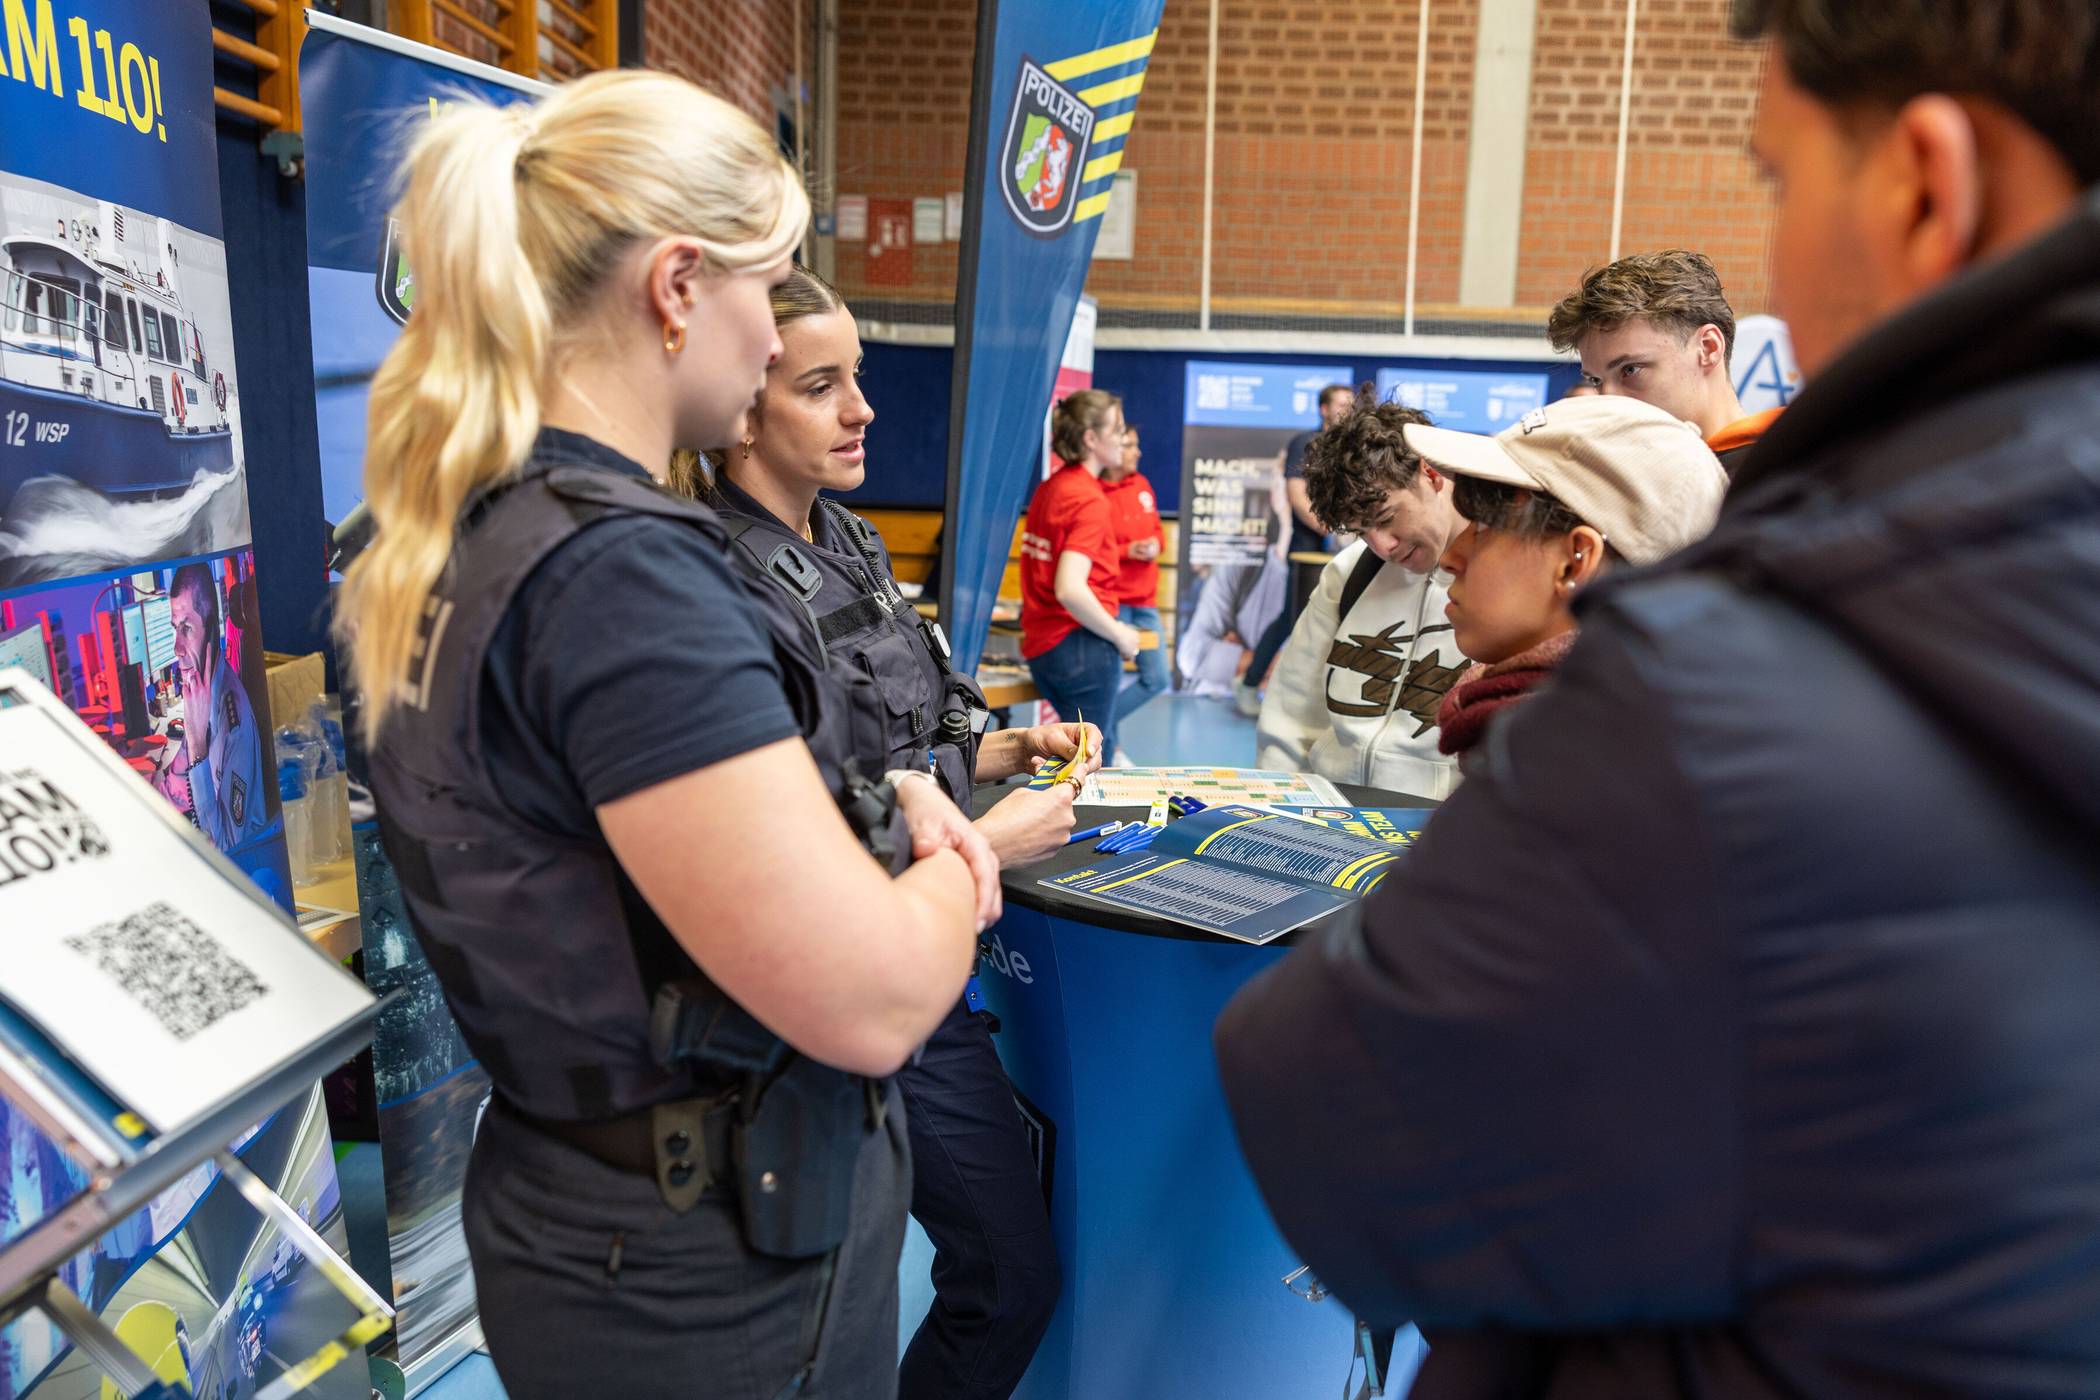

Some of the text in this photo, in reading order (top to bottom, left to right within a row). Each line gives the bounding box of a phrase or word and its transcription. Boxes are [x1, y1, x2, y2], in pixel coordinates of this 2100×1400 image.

[0, 0, 167, 143] M 110!
[1024, 71, 1088, 137] POLIZEI
[6, 410, 70, 447] 12 WSP
[1193, 478, 1244, 496] WAS
[1054, 869, 1099, 884] Kontakt
